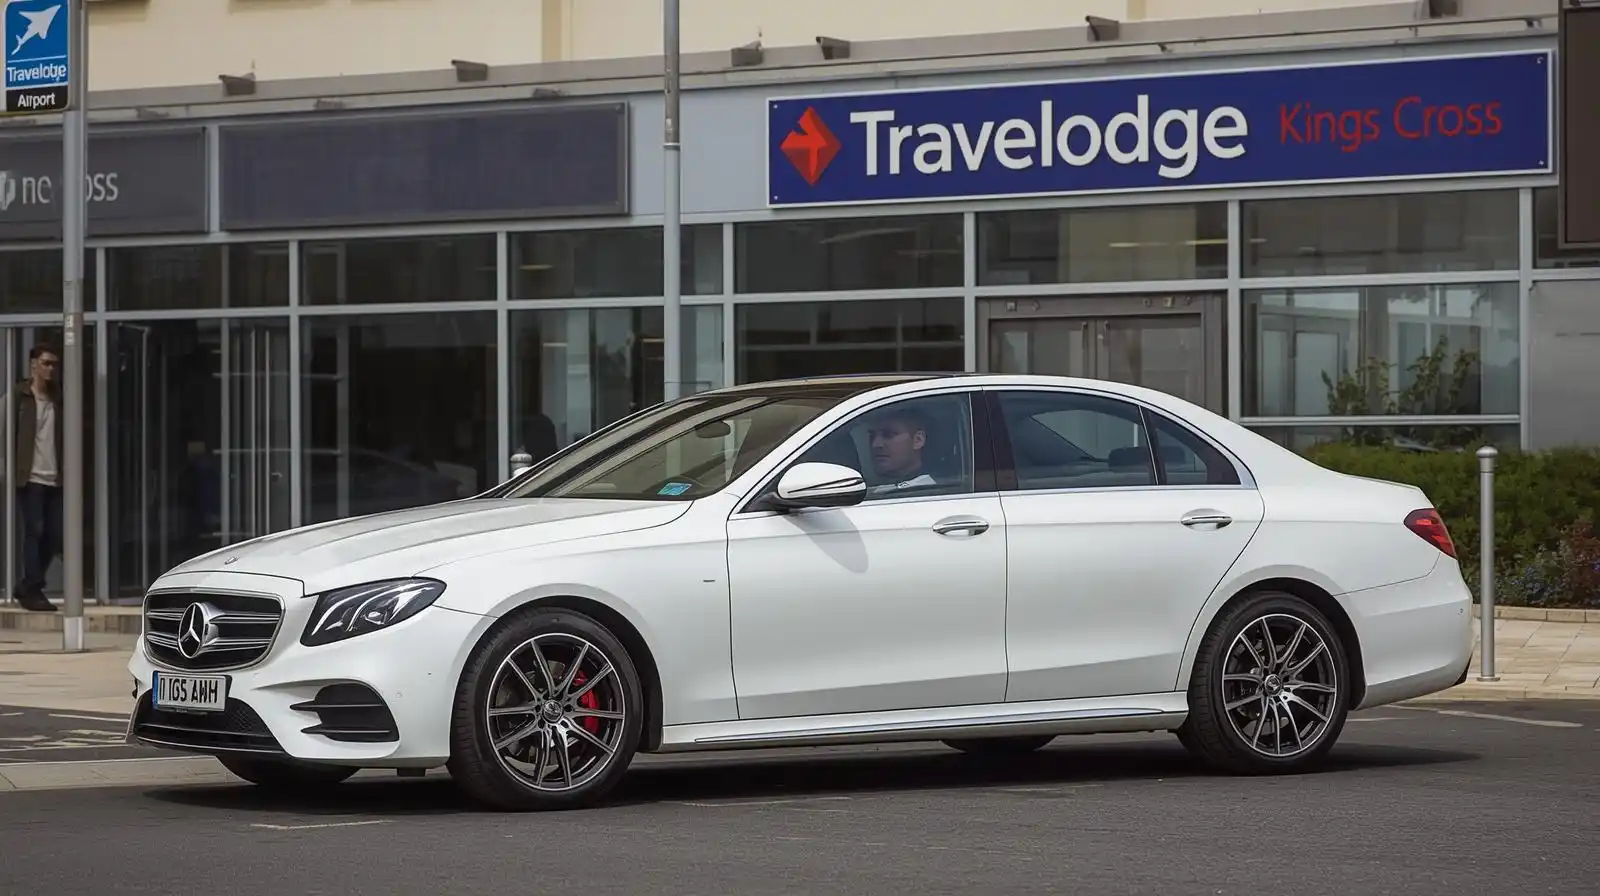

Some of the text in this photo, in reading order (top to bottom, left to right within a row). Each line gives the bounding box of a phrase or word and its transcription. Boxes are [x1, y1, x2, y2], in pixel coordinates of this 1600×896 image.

[850, 94, 1503, 178] Travelodge Kings Cross
